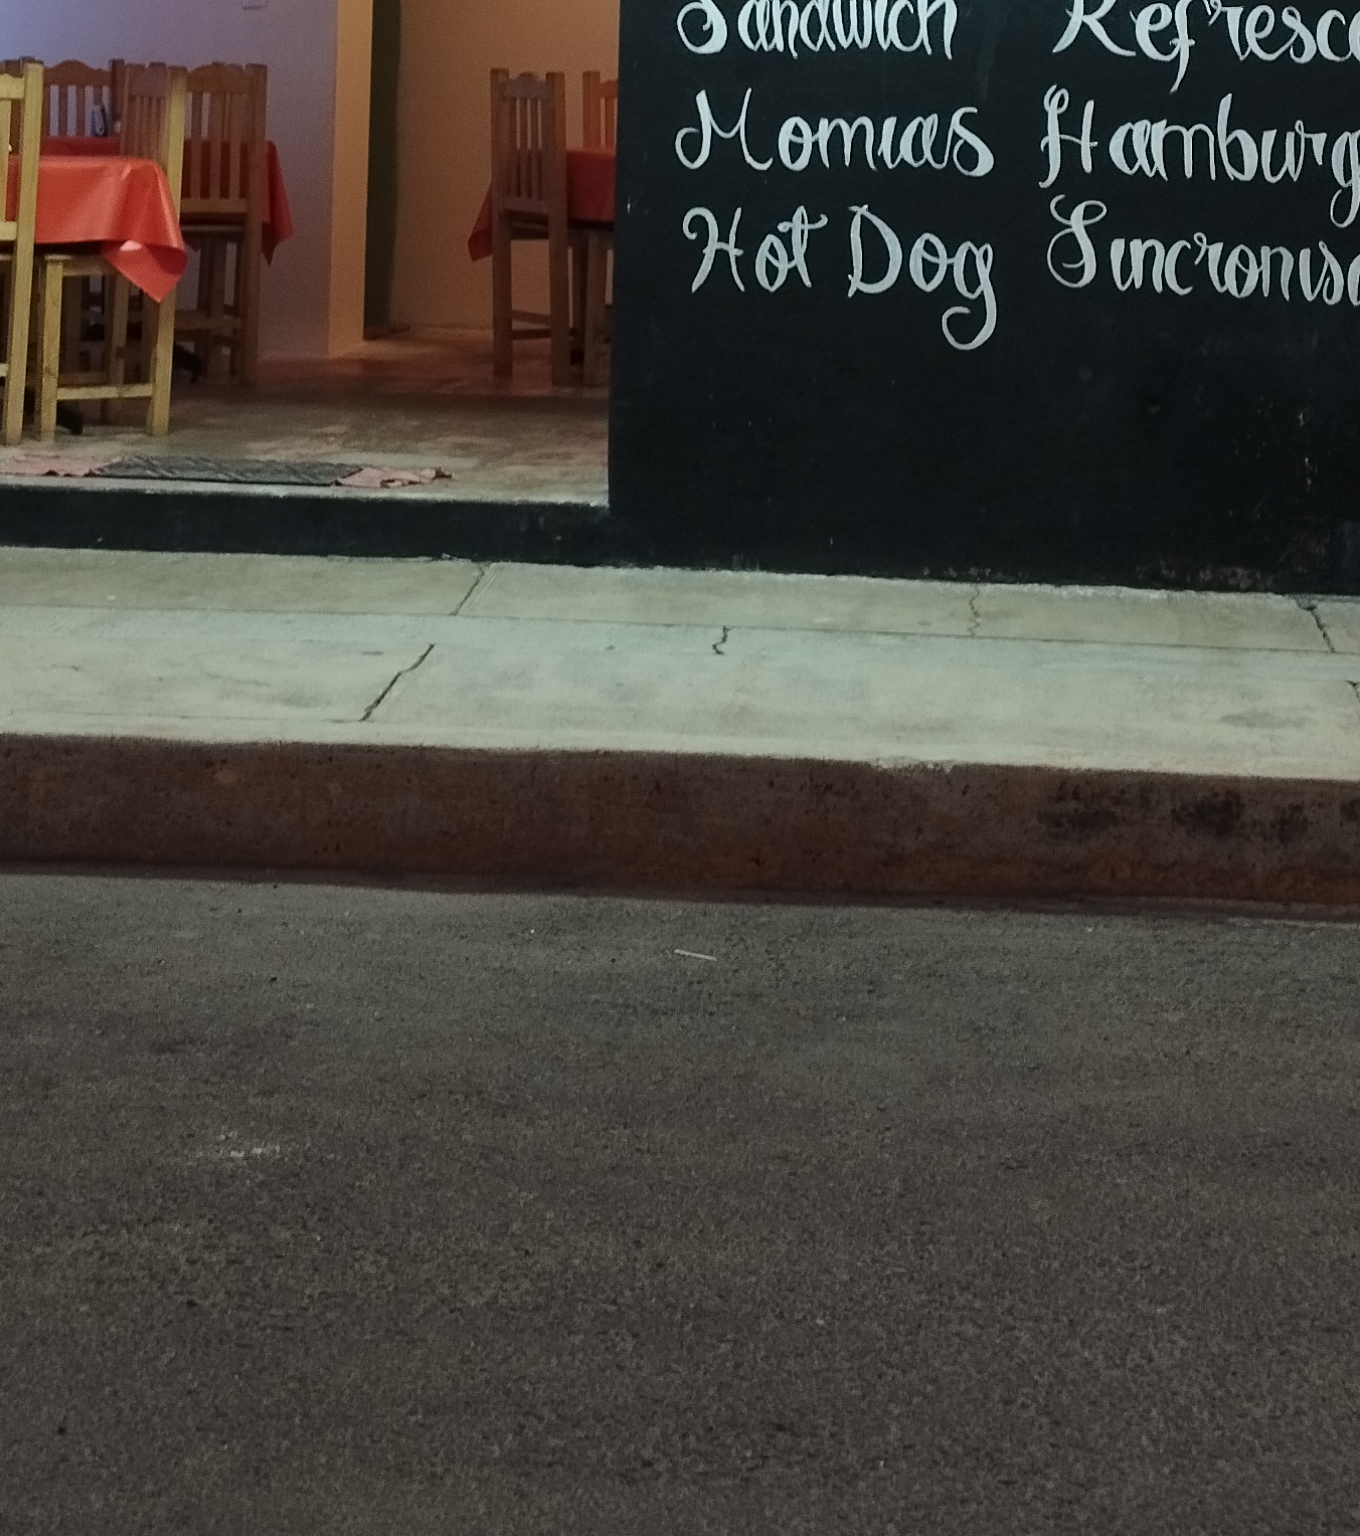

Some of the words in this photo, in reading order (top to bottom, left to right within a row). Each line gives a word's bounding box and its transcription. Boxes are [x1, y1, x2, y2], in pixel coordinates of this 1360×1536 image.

[675, 87, 995, 177] Momias
[683, 205, 828, 293] Hot
[847, 204, 997, 351] Dog
